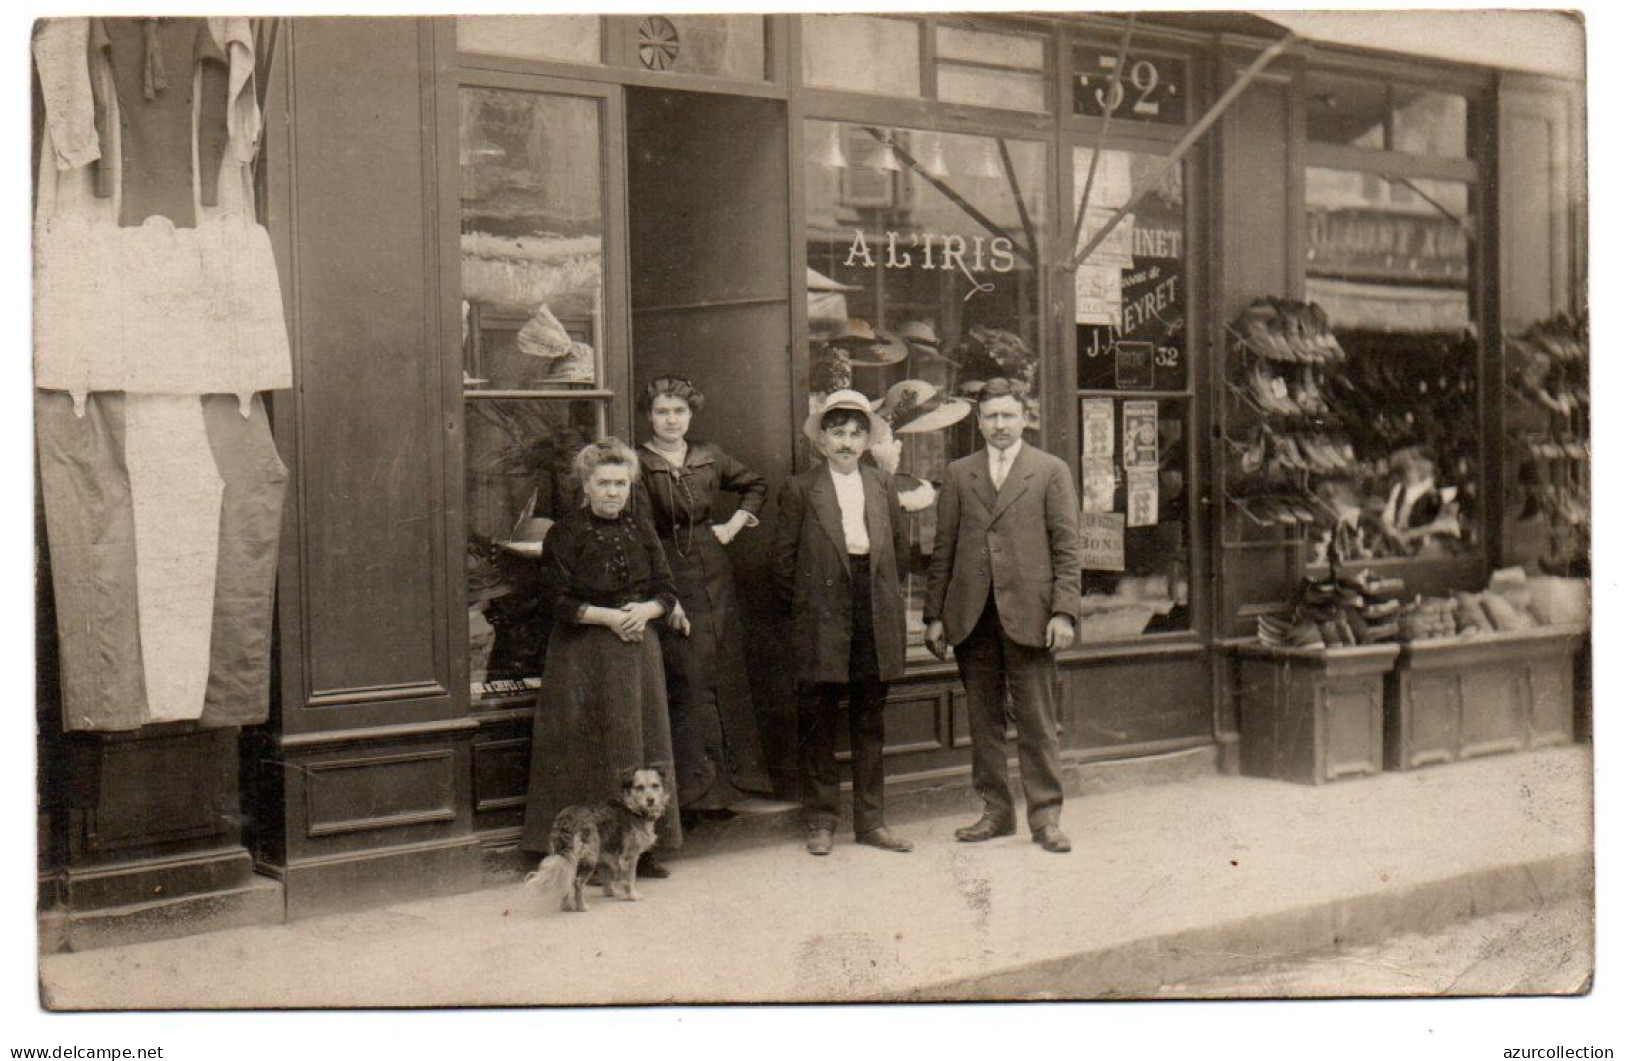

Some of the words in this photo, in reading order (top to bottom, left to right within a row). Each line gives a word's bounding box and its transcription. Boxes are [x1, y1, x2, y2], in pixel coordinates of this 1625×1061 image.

[1095, 56, 1159, 115] 32
[1132, 228, 1182, 258] INET
[1155, 347, 1179, 366] 32
